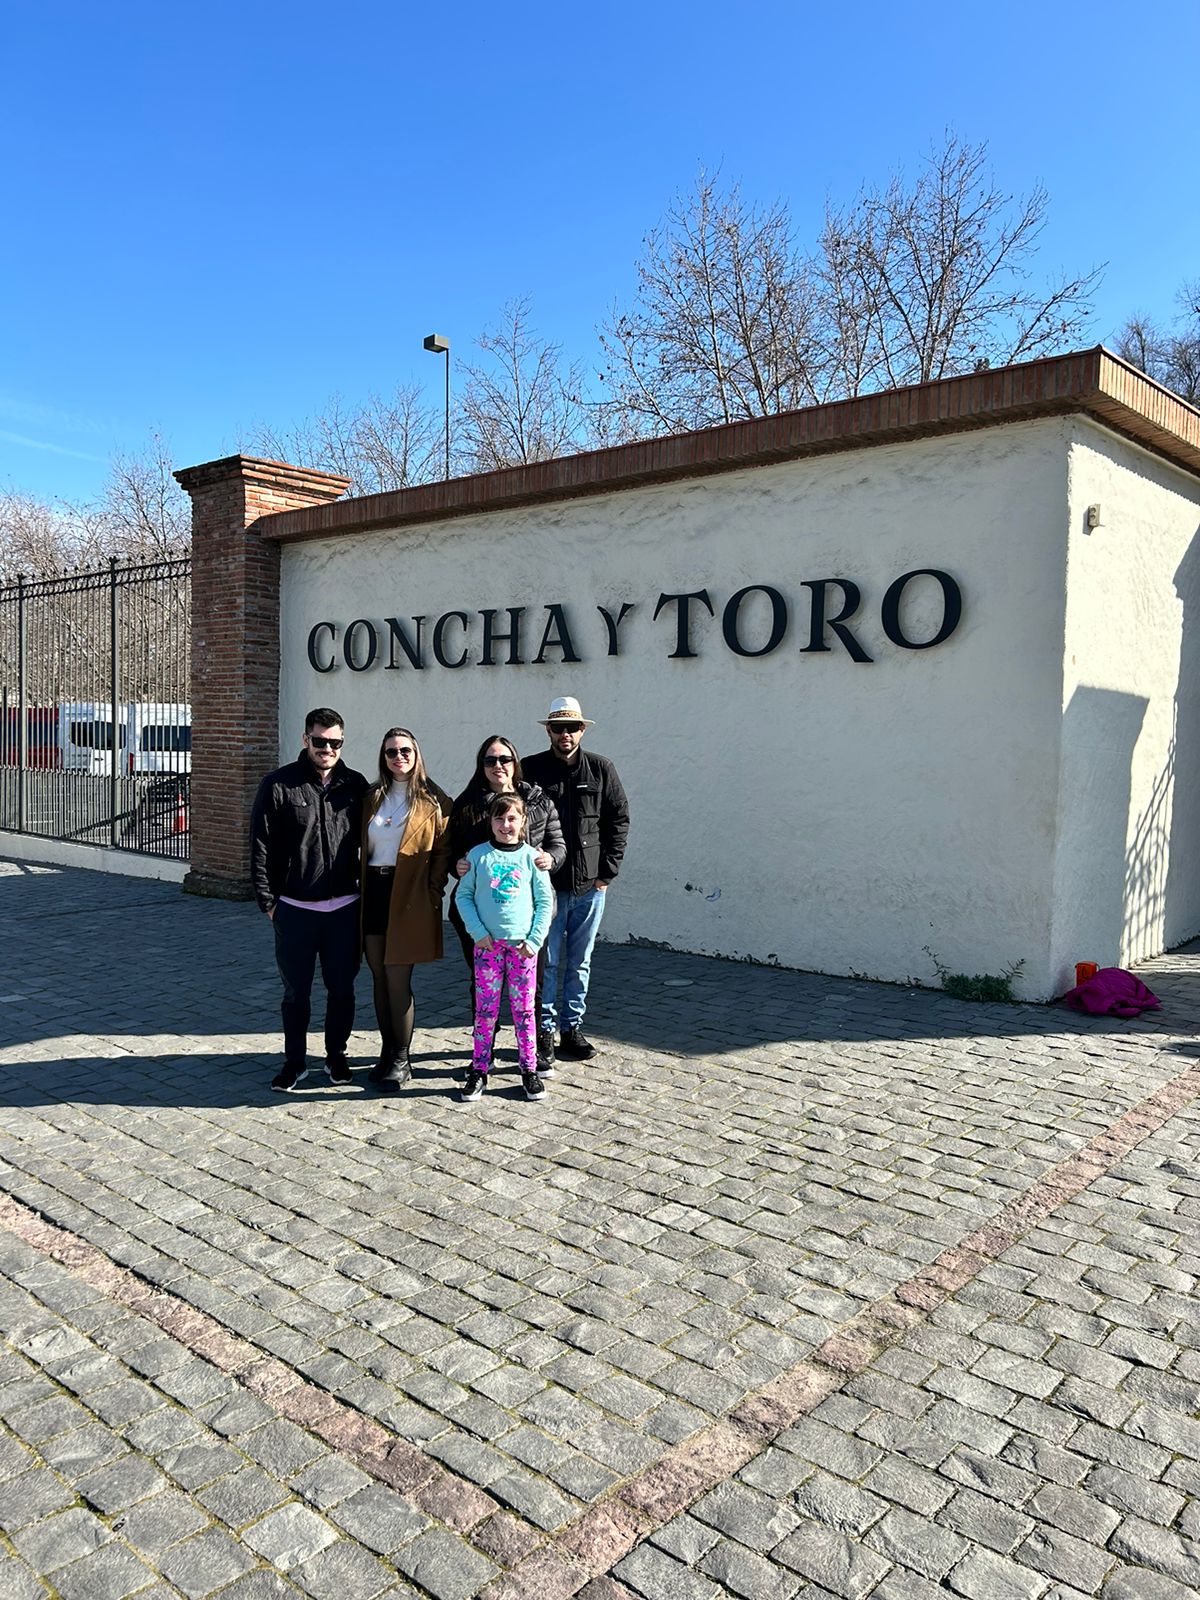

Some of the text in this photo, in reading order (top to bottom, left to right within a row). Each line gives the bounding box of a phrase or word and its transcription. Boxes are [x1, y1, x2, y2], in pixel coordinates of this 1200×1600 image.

[307, 568, 963, 674] CONCHA Y TORO
